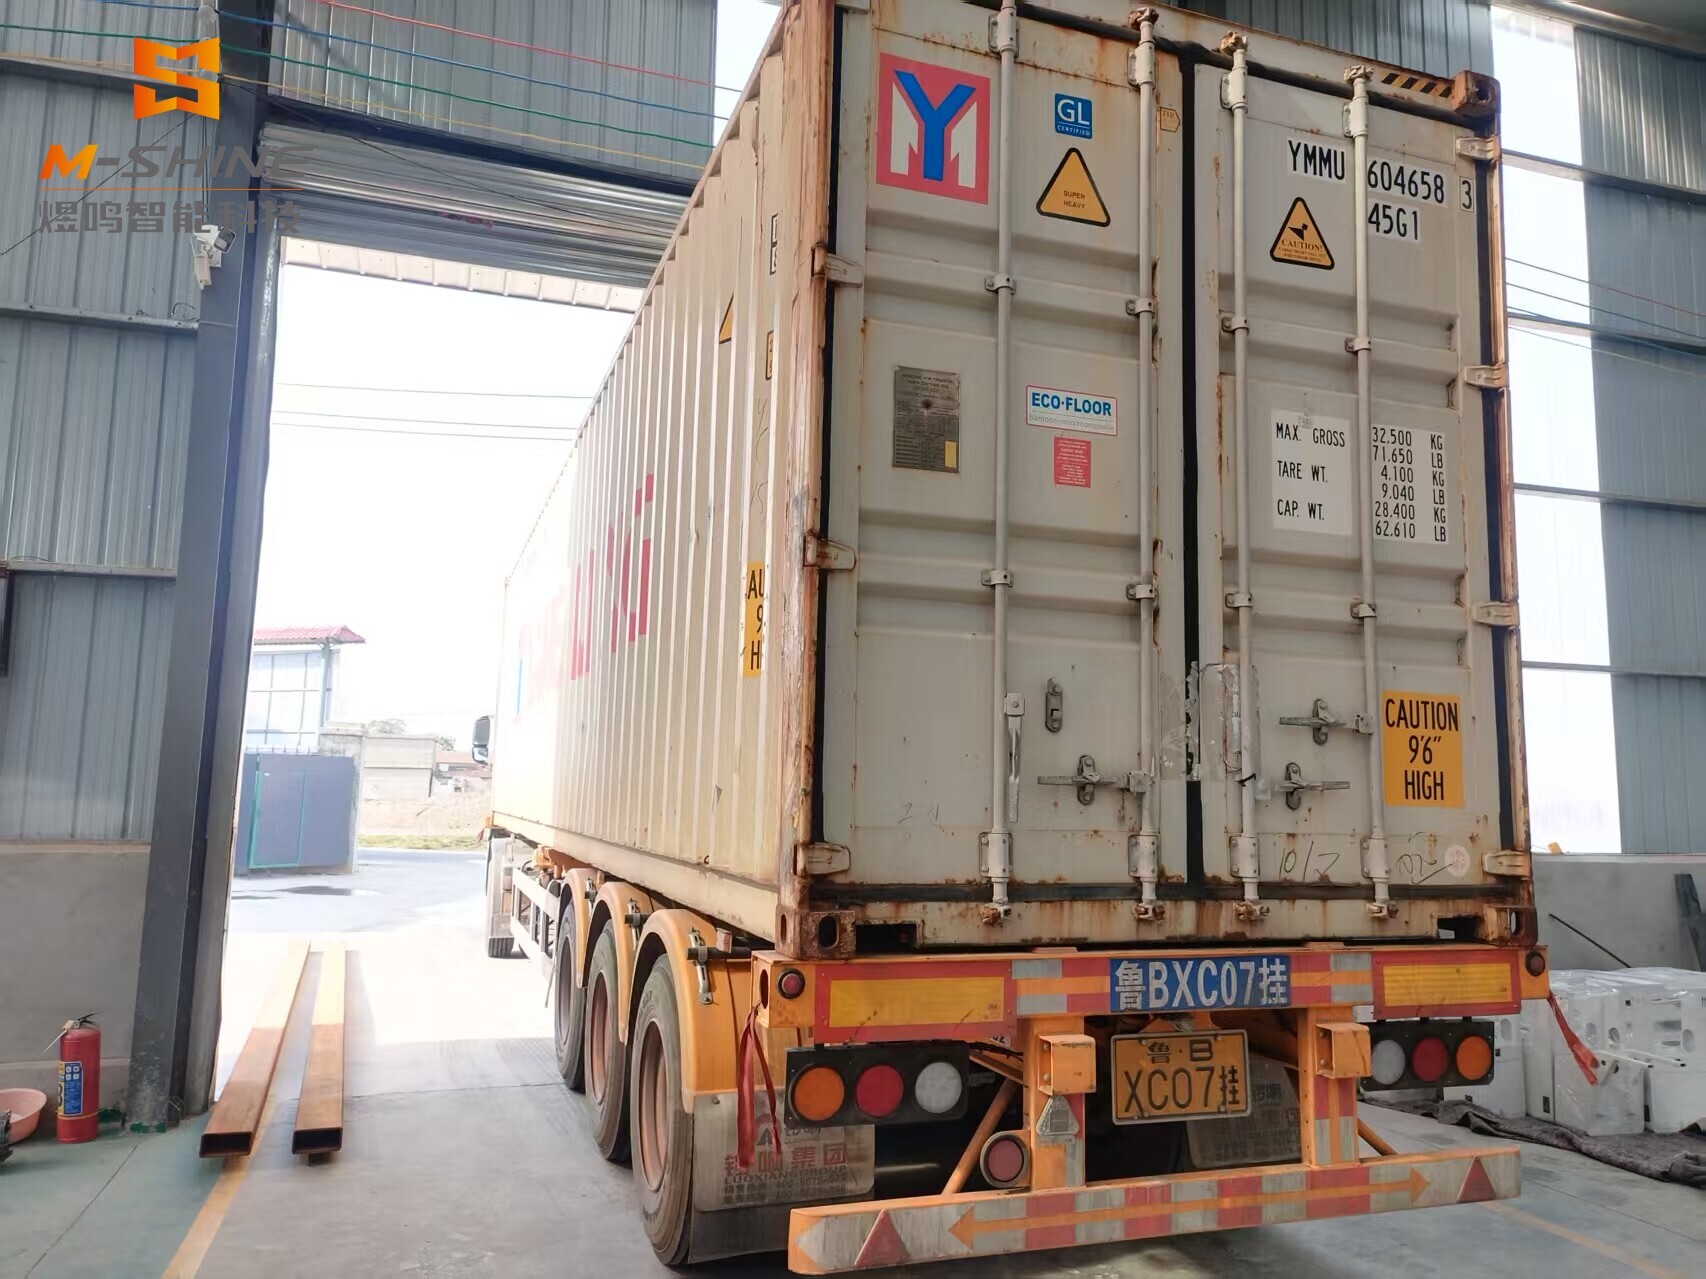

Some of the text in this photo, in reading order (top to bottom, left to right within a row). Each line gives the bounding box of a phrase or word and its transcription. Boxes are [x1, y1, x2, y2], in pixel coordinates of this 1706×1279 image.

[1058, 99, 1090, 125] GL
[1288, 140, 1472, 210] YMMU 604658 3
[1063, 190, 1086, 200] SUPER
[1368, 202, 1418, 240] 45G1
[1276, 422, 1301, 441] MAX.
[1312, 428, 1345, 447] GROSS
[1430, 433, 1443, 450] KG
[1277, 460, 1303, 480] TARE
[1311, 465, 1328, 483] WT.
[1432, 470, 1445, 487] KG
[1432, 453, 1444, 469] LB
[1433, 489, 1445, 505] LB
[1277, 499, 1300, 517] CAP.
[1308, 503, 1325, 521] WT.
[1434, 507, 1446, 524] KG
[1435, 526, 1446, 542] LB
[1385, 699, 1459, 731] CAUTION
[1404, 769, 1444, 800] HIGH
[1115, 957, 1288, 1011] 鲁BXC07挂
[1124, 1065, 1240, 1113] XC07挂
